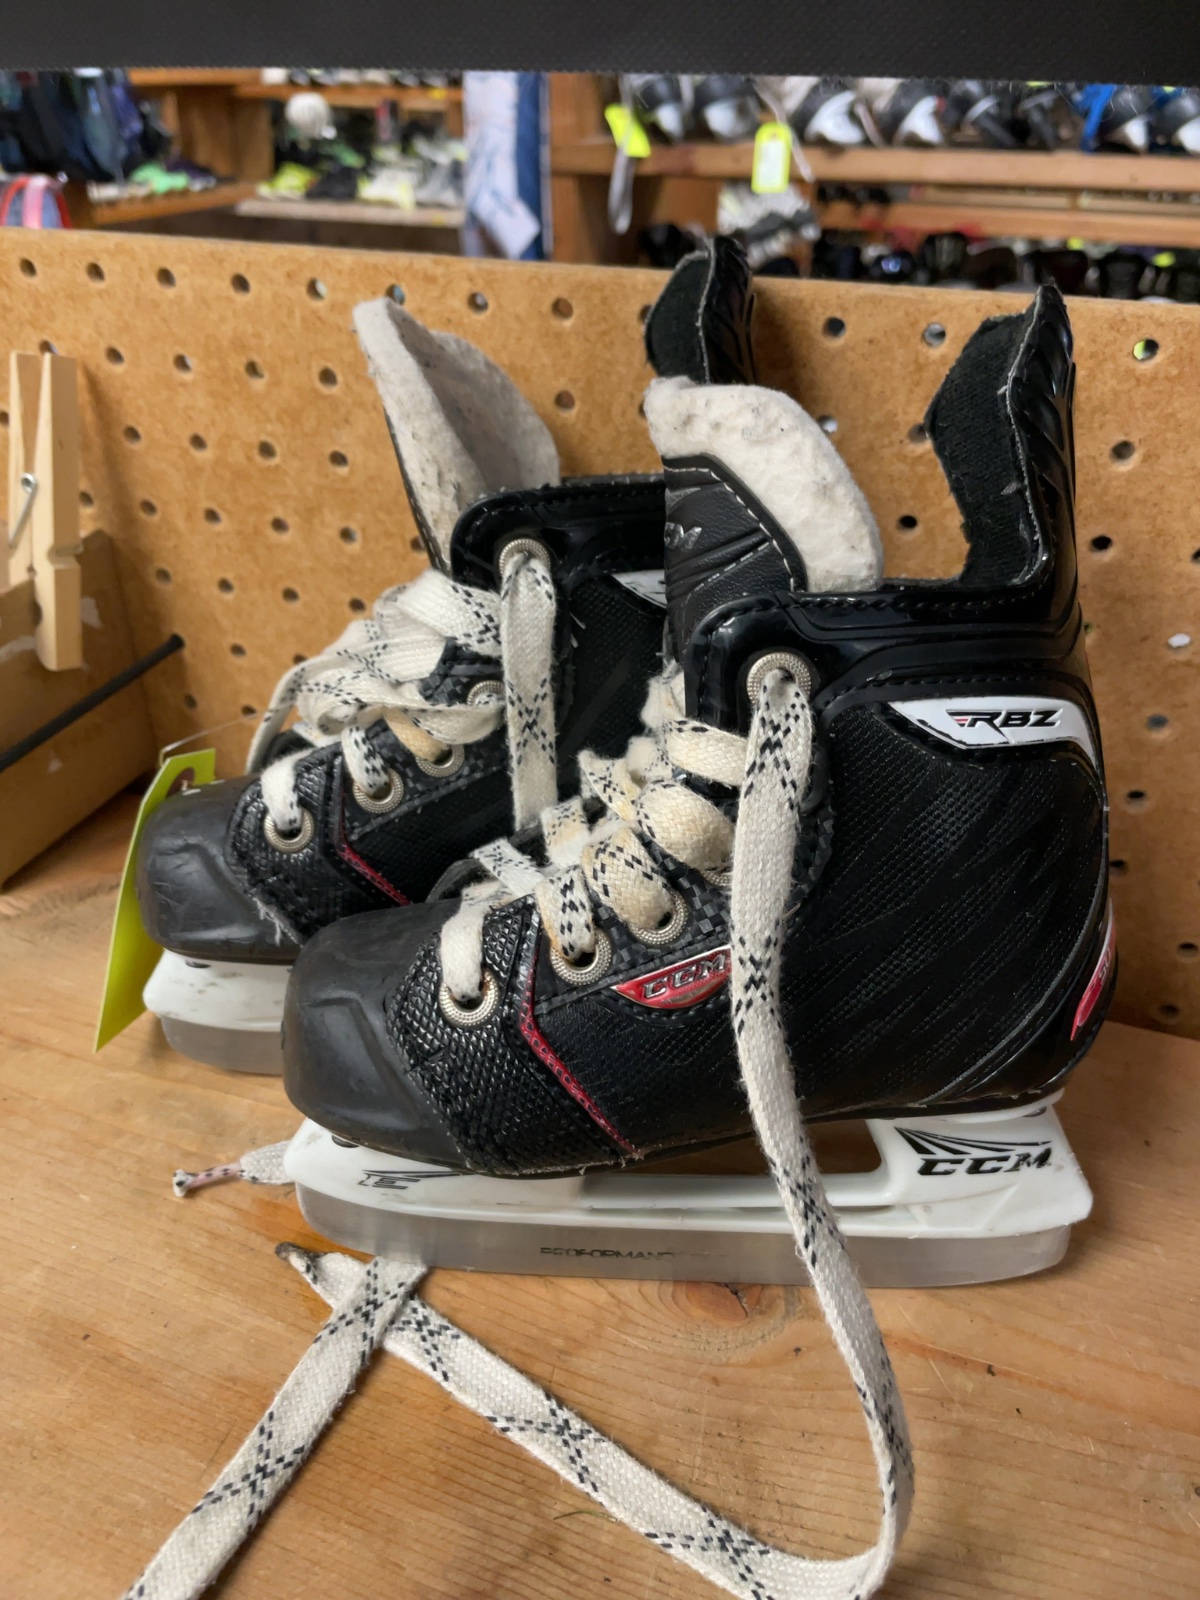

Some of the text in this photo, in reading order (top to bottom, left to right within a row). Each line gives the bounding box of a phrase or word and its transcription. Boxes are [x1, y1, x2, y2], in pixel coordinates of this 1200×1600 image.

[947, 709, 1063, 736] RBZ
[642, 953, 726, 999] CCM
[917, 1147, 1053, 1176] CCM
